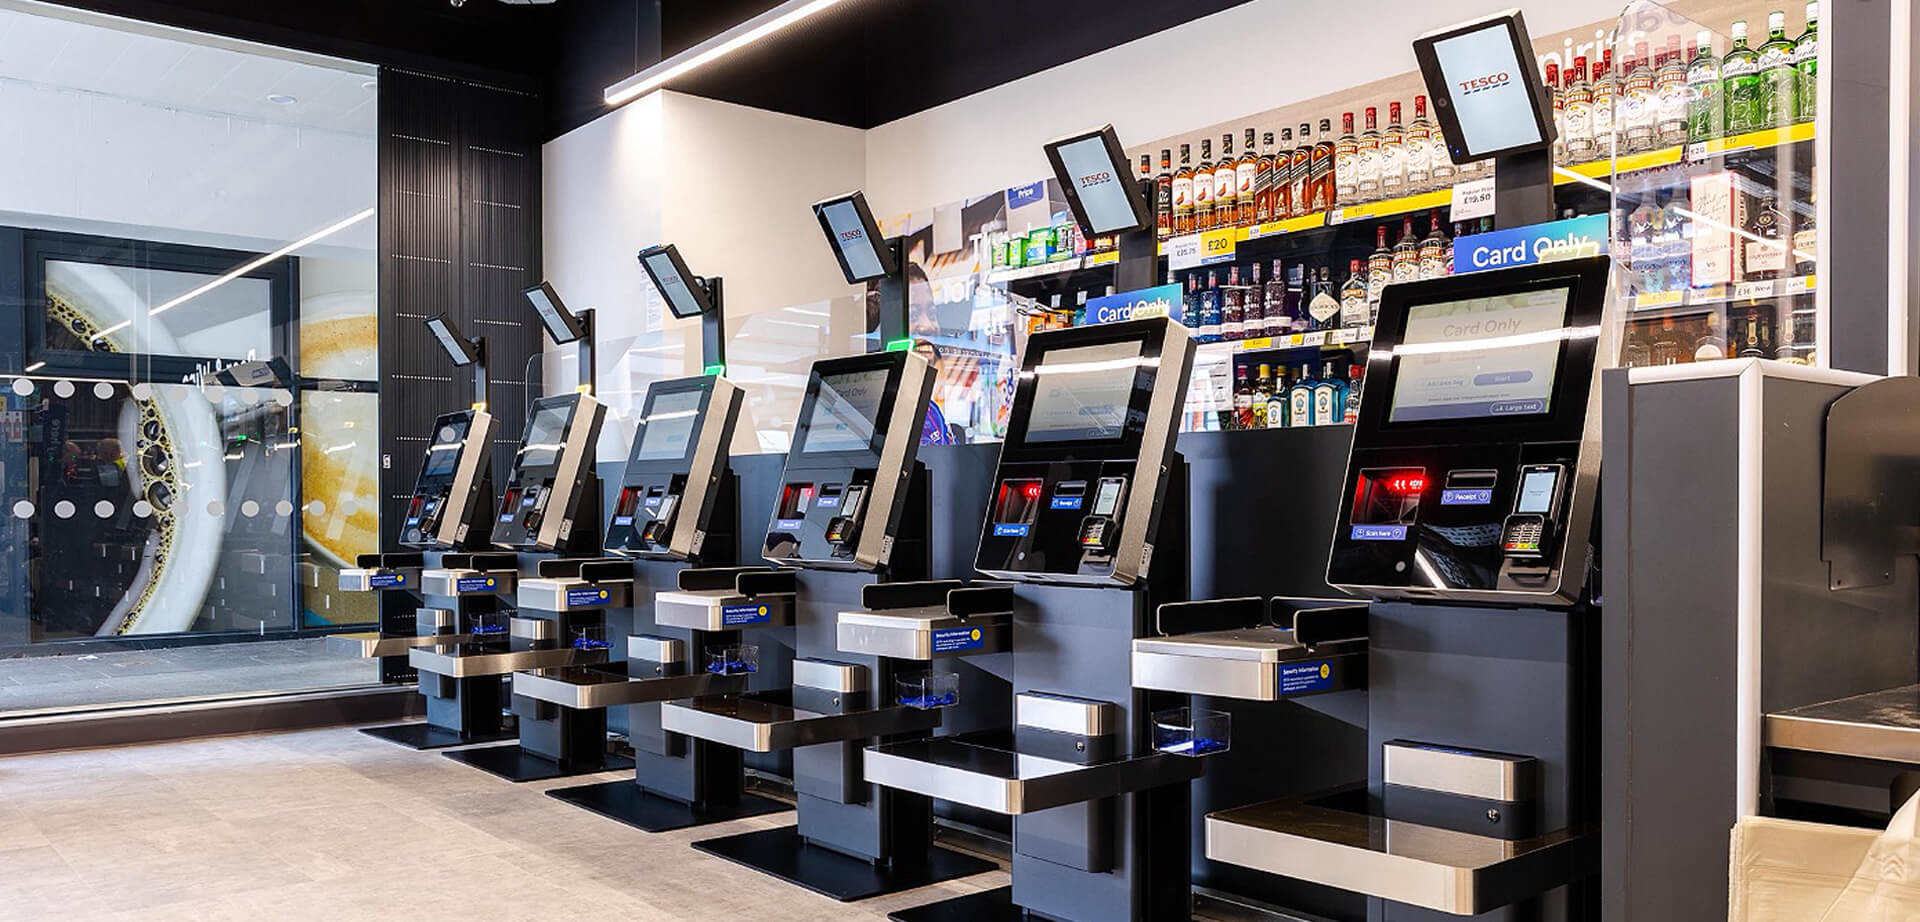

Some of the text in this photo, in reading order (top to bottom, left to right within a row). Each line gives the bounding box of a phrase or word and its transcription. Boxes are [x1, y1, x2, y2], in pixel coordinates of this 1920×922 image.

[1459, 72, 1509, 91] TESCO
[1079, 171, 1110, 184] TESCO
[841, 229, 862, 239] TESCO
[1208, 238, 1228, 251] £20
[1473, 232, 1589, 268] Card Only
[1097, 302, 1132, 323] Card
[1135, 297, 1170, 317] Only
[1443, 318, 1521, 337] Card Only
